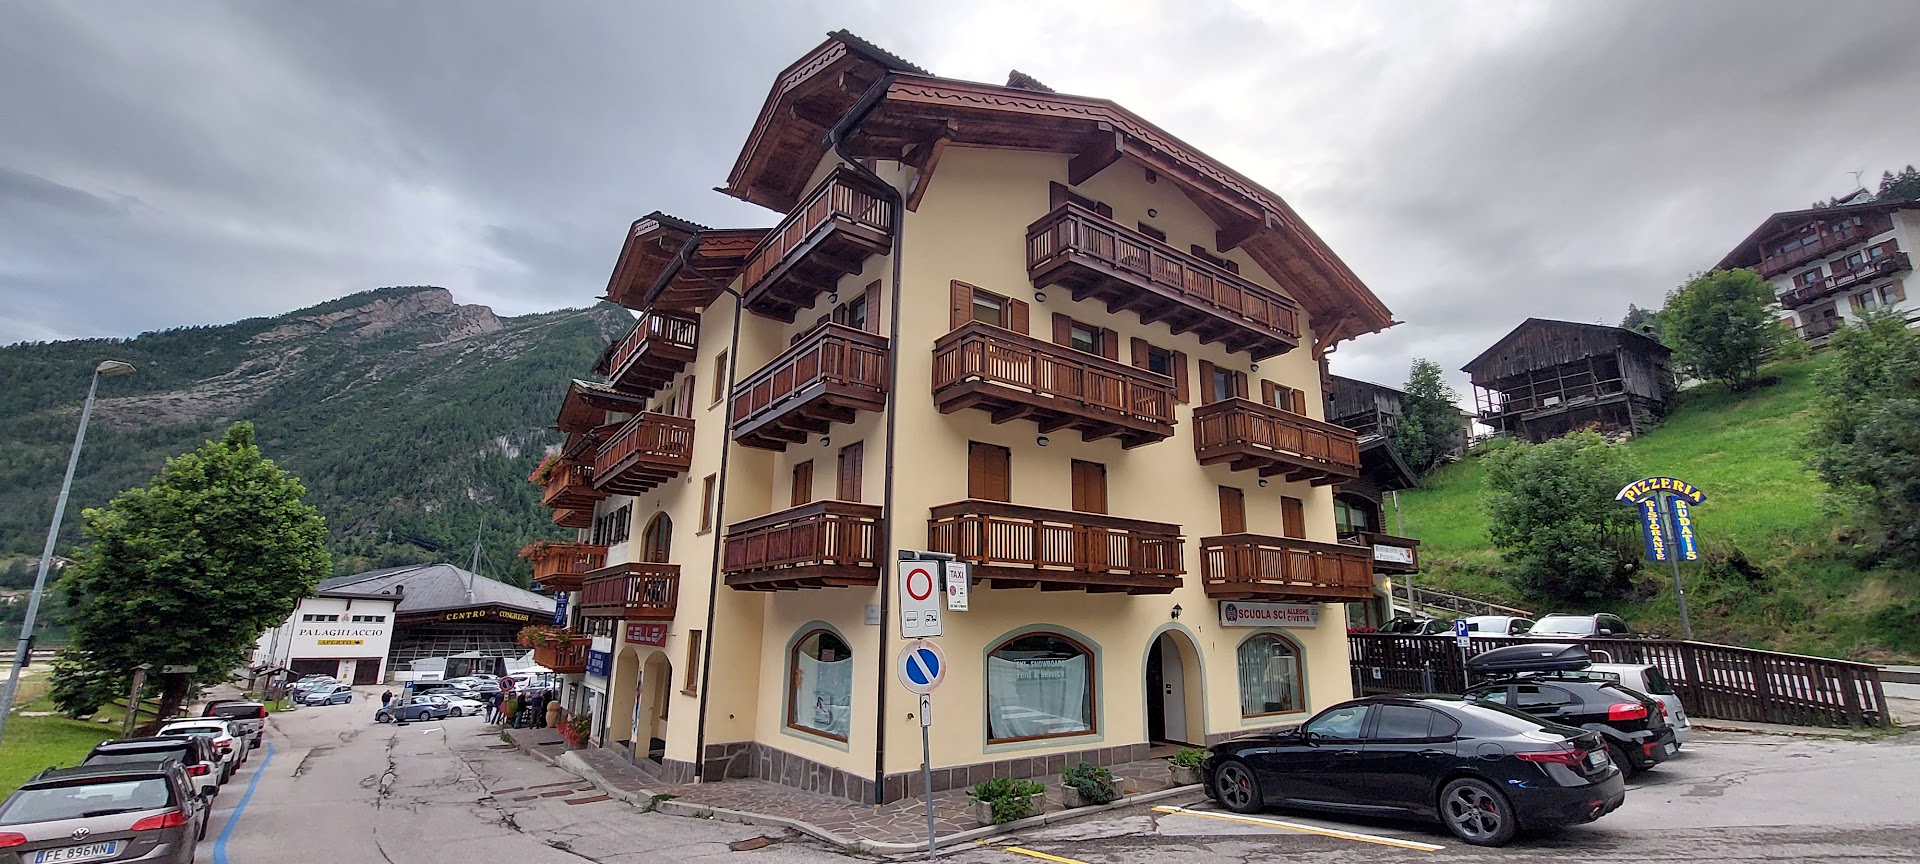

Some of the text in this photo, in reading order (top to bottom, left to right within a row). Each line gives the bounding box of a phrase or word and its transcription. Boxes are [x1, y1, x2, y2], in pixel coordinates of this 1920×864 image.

[1624, 478, 1701, 502] PIZZERIA
[1645, 500, 1665, 560] RISTORANTE
[1676, 500, 1697, 560] RUDATIS
[950, 570, 964, 578] TAXI
[446, 610, 529, 621] CENTRO CONGRESSI
[1239, 609, 1286, 620] SCUOLA SCI
[1457, 621, 1466, 636] P
[45, 844, 108, 862] FE 896NN
